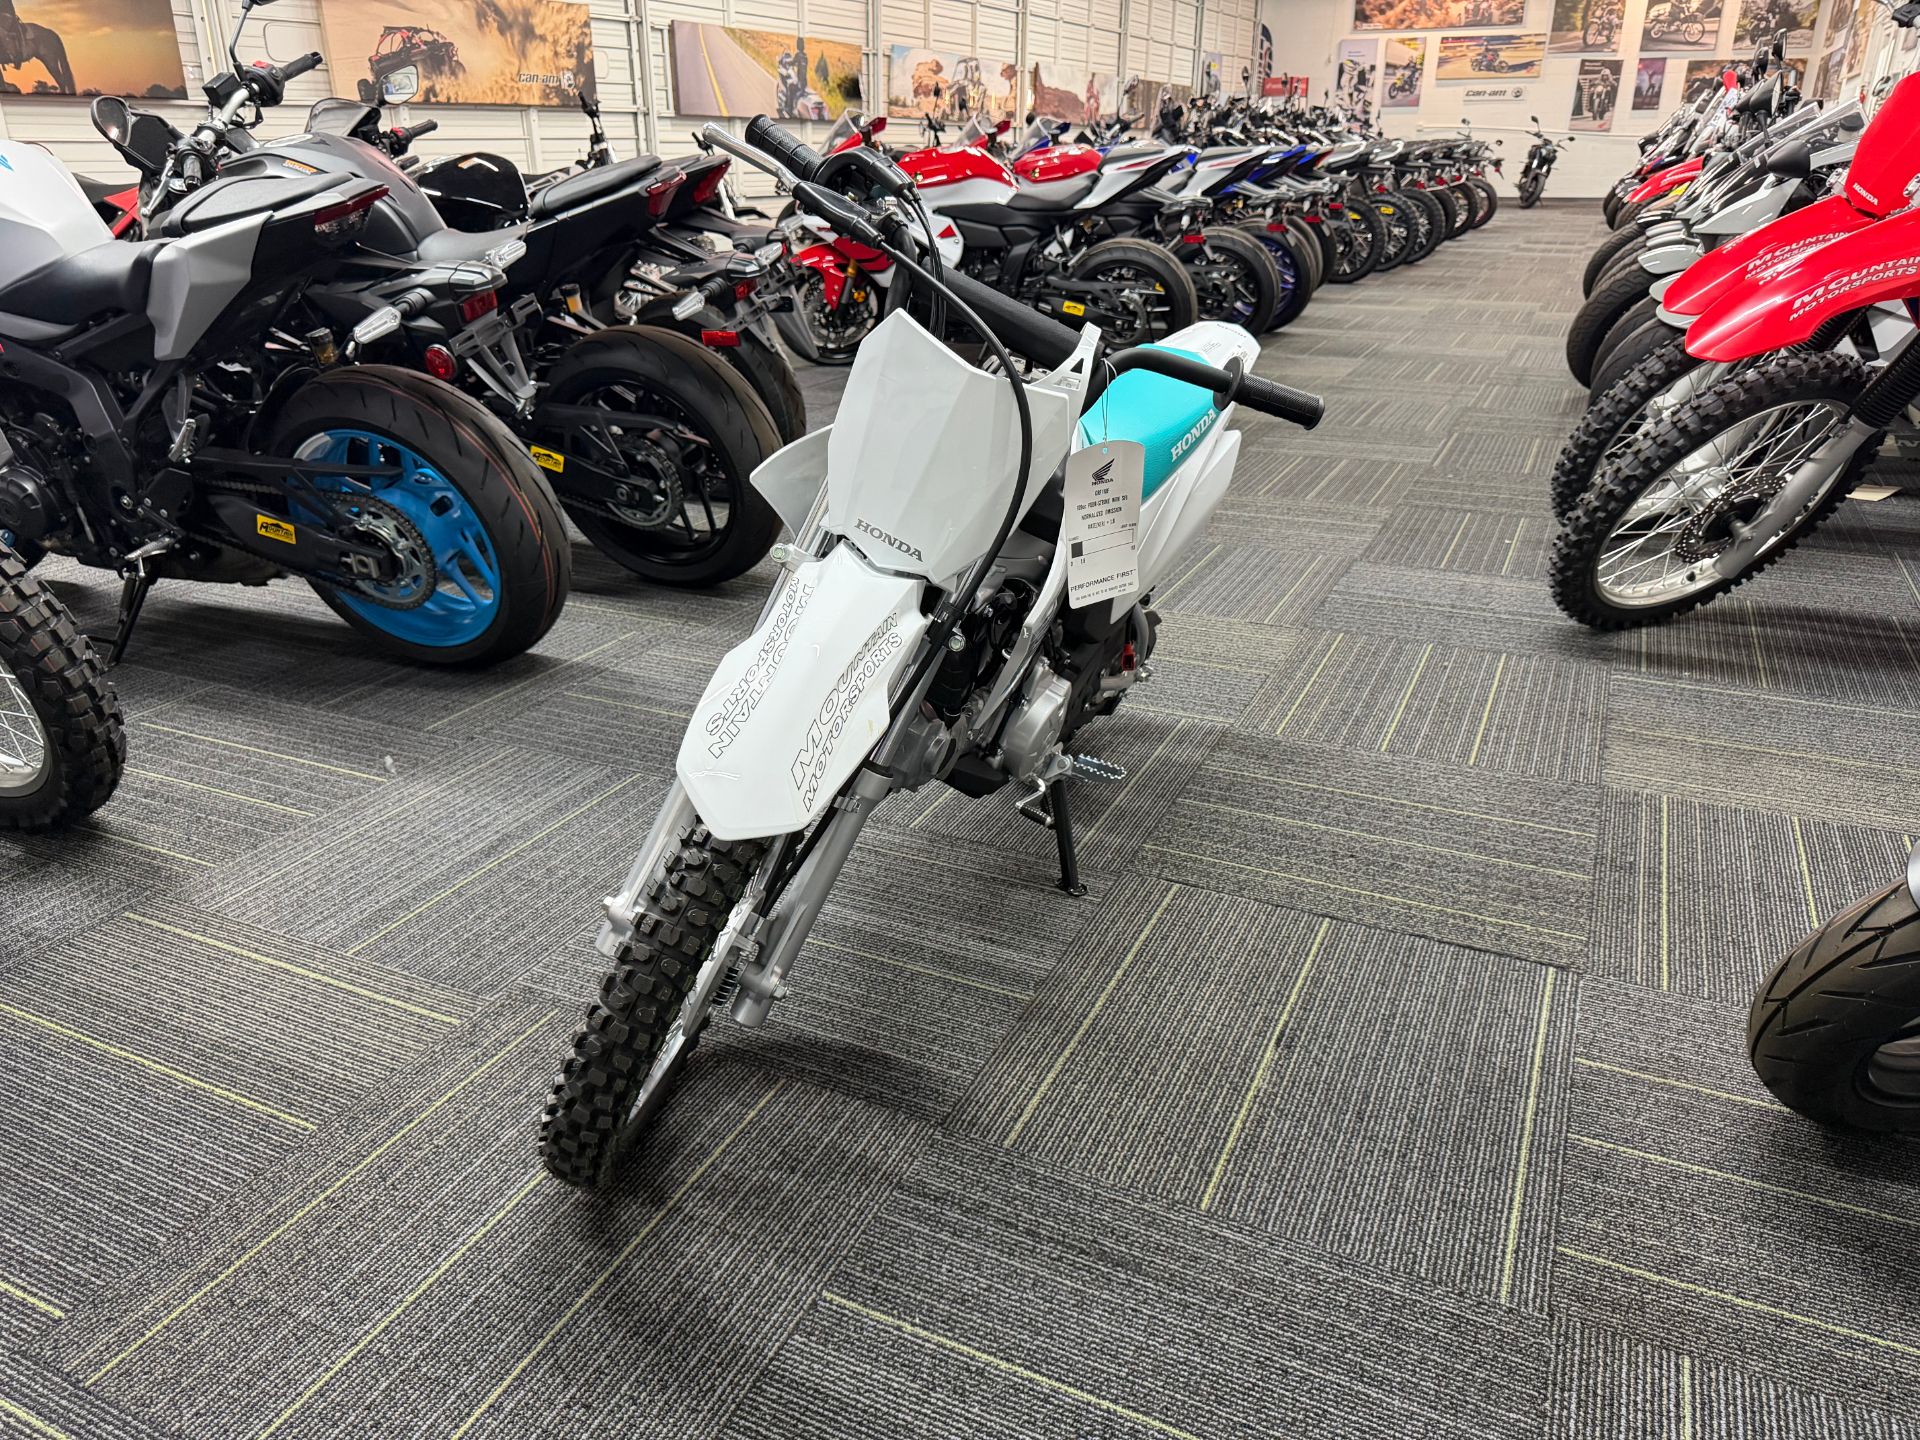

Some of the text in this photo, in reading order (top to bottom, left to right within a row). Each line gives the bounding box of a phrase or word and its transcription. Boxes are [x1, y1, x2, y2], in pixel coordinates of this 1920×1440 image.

[1853, 182, 1879, 206] HONDA
[1789, 265, 1918, 322] MOTORSPORTS
[1170, 408, 1217, 463] HONDA
[1091, 478, 1114, 487] HONDA
[854, 518, 924, 563] HONDA
[1070, 574, 1115, 593] PERFORMANCE
[705, 576, 800, 736] MOTORSPORTS
[707, 583, 815, 760] MOUNTAIN
[790, 612, 900, 791] MOUNTAIN
[802, 632, 903, 813] MOTORSPORTS
